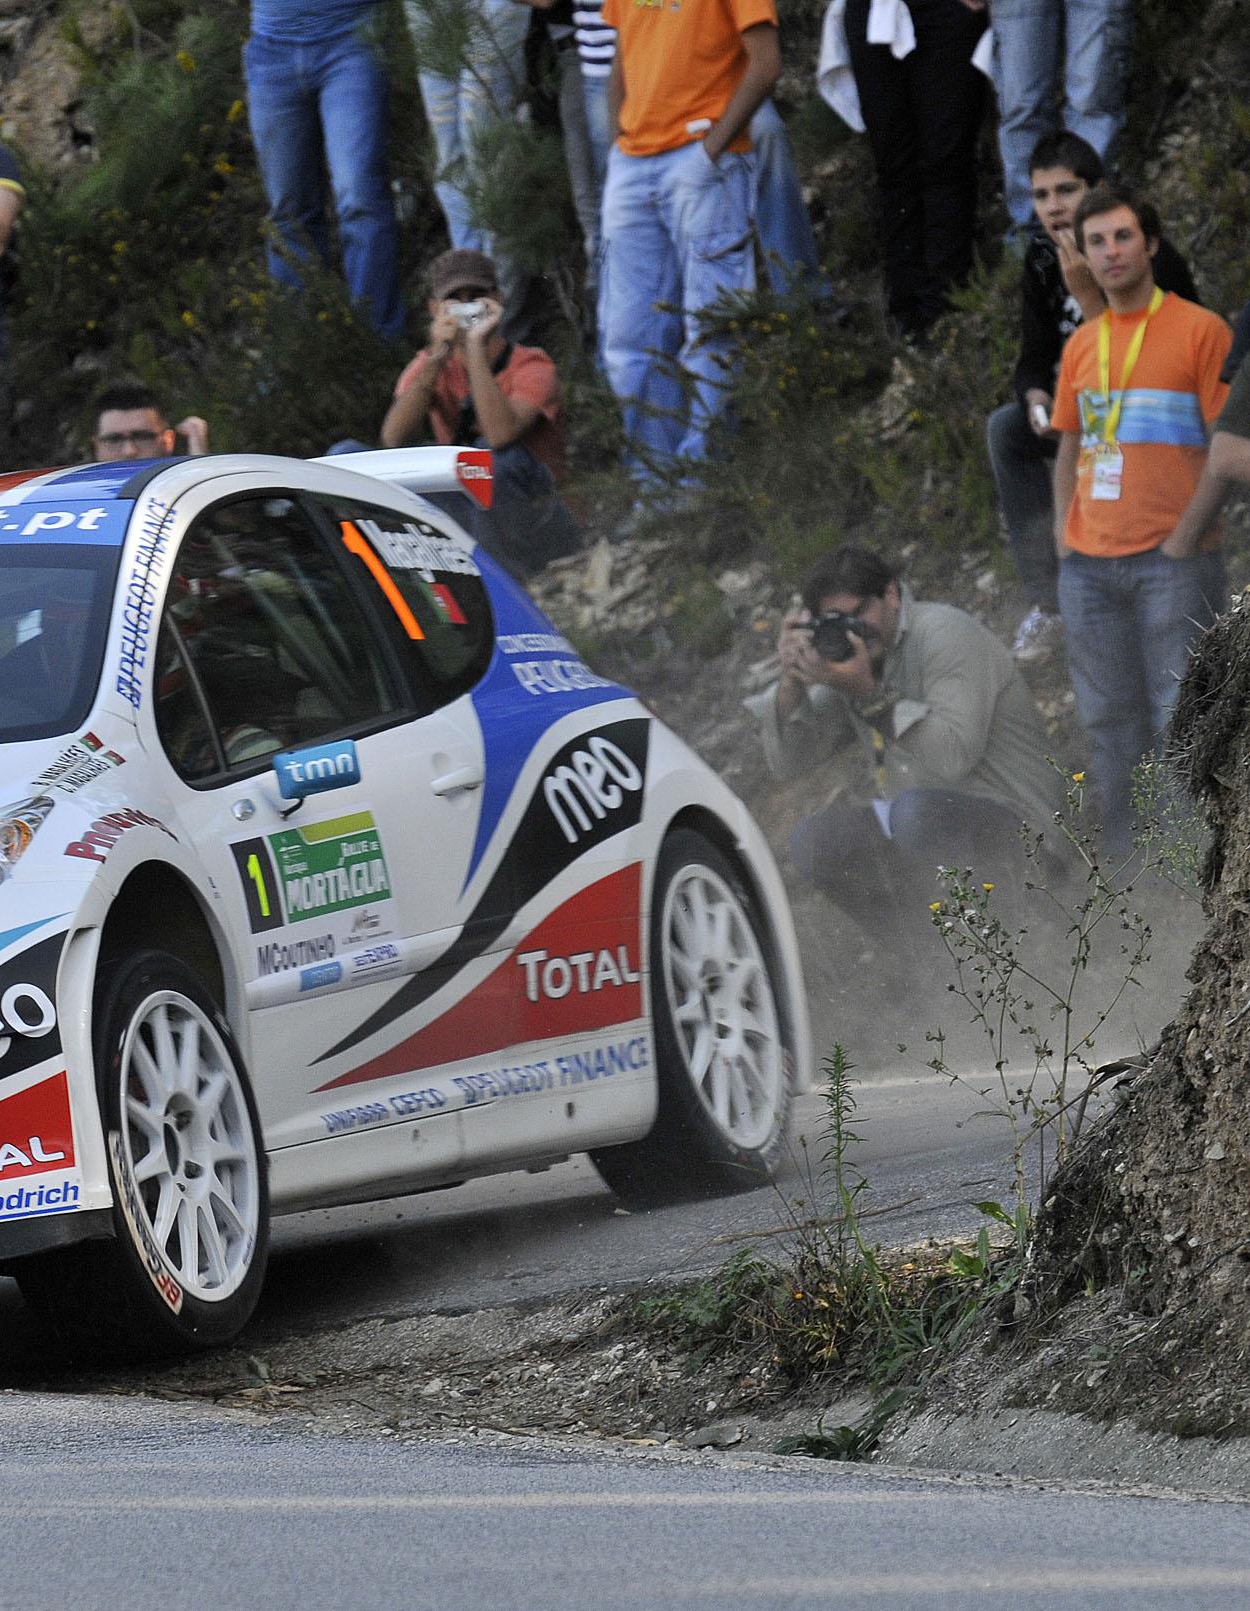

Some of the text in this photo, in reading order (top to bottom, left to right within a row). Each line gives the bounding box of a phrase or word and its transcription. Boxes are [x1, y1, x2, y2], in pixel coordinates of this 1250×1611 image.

[339, 520, 426, 640] 1
[284, 751, 354, 783] tmn
[544, 735, 642, 844] meo
[246, 854, 271, 917] 1
[517, 945, 640, 1002] TOTAL
[554, 1037, 648, 1087] FINANCE
